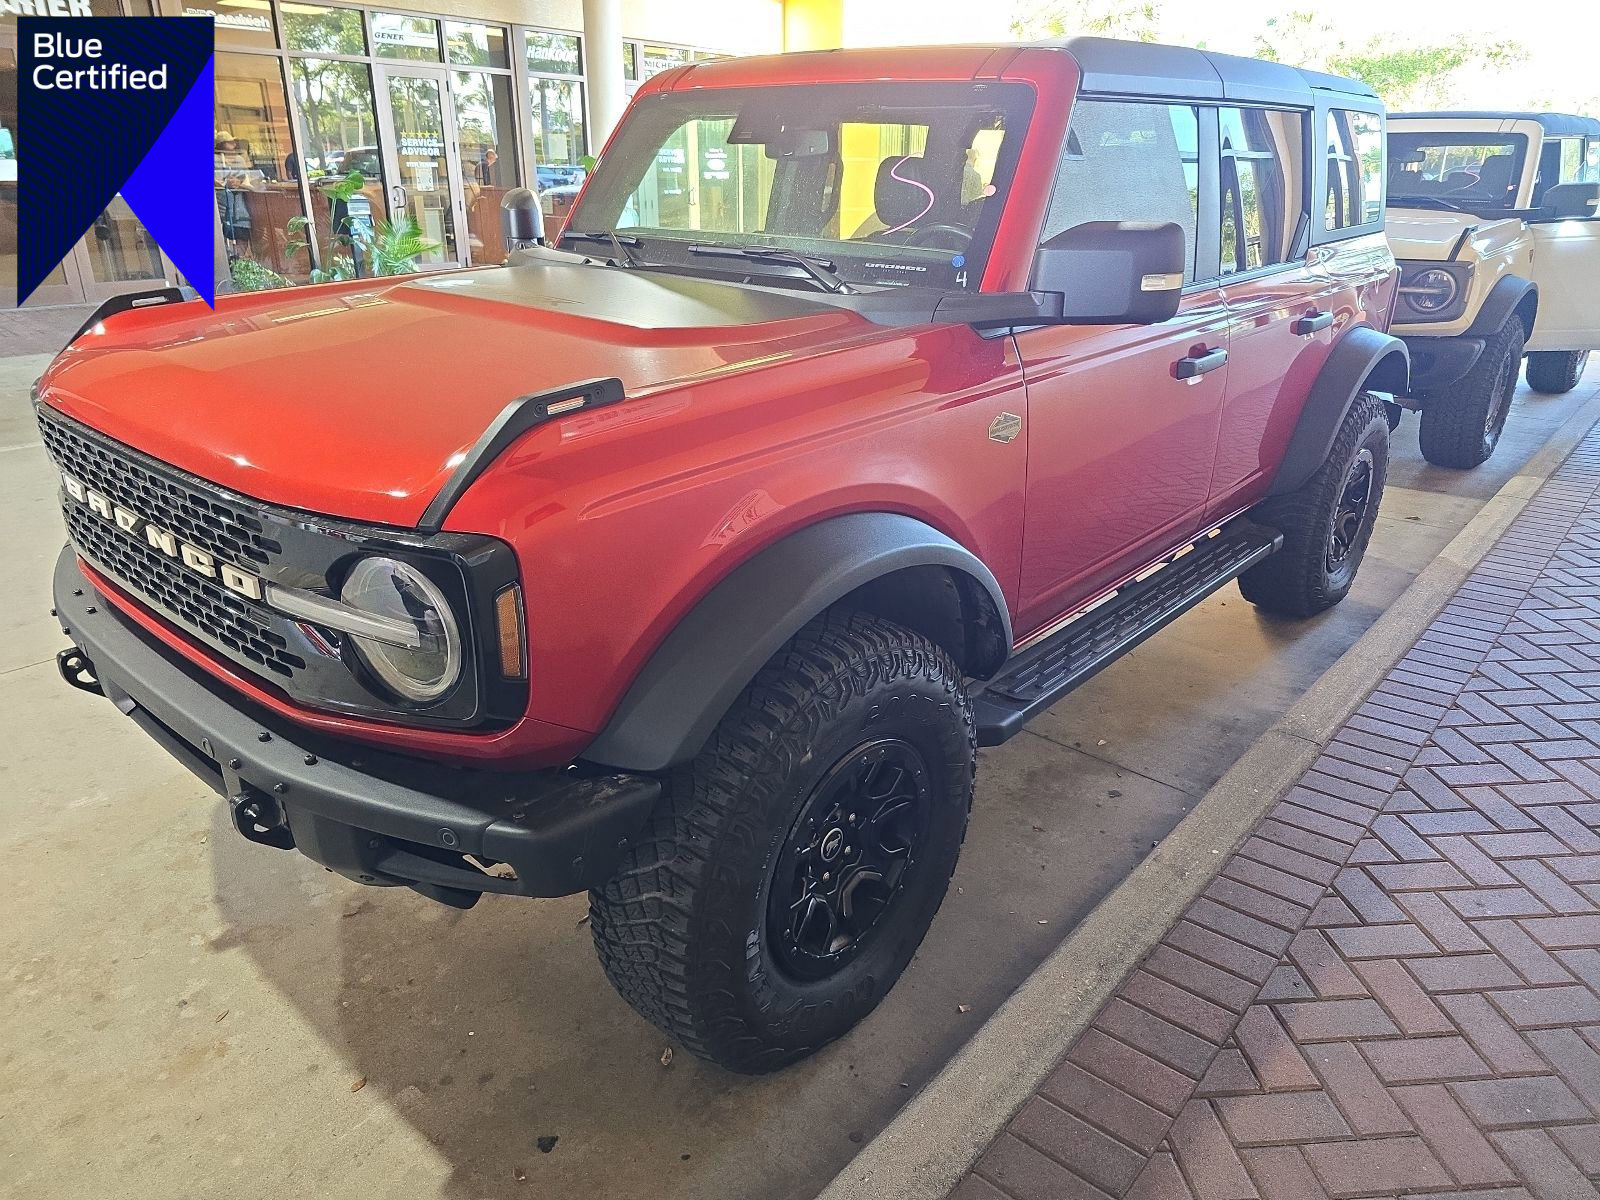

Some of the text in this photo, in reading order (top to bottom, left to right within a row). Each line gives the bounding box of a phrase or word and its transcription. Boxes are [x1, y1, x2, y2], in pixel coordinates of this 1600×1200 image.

[401, 138, 439, 147] SERVICE
[401, 147, 441, 156] ADVISOR
[955, 271, 967, 288] 4
[65, 474, 261, 600] BRONCO
